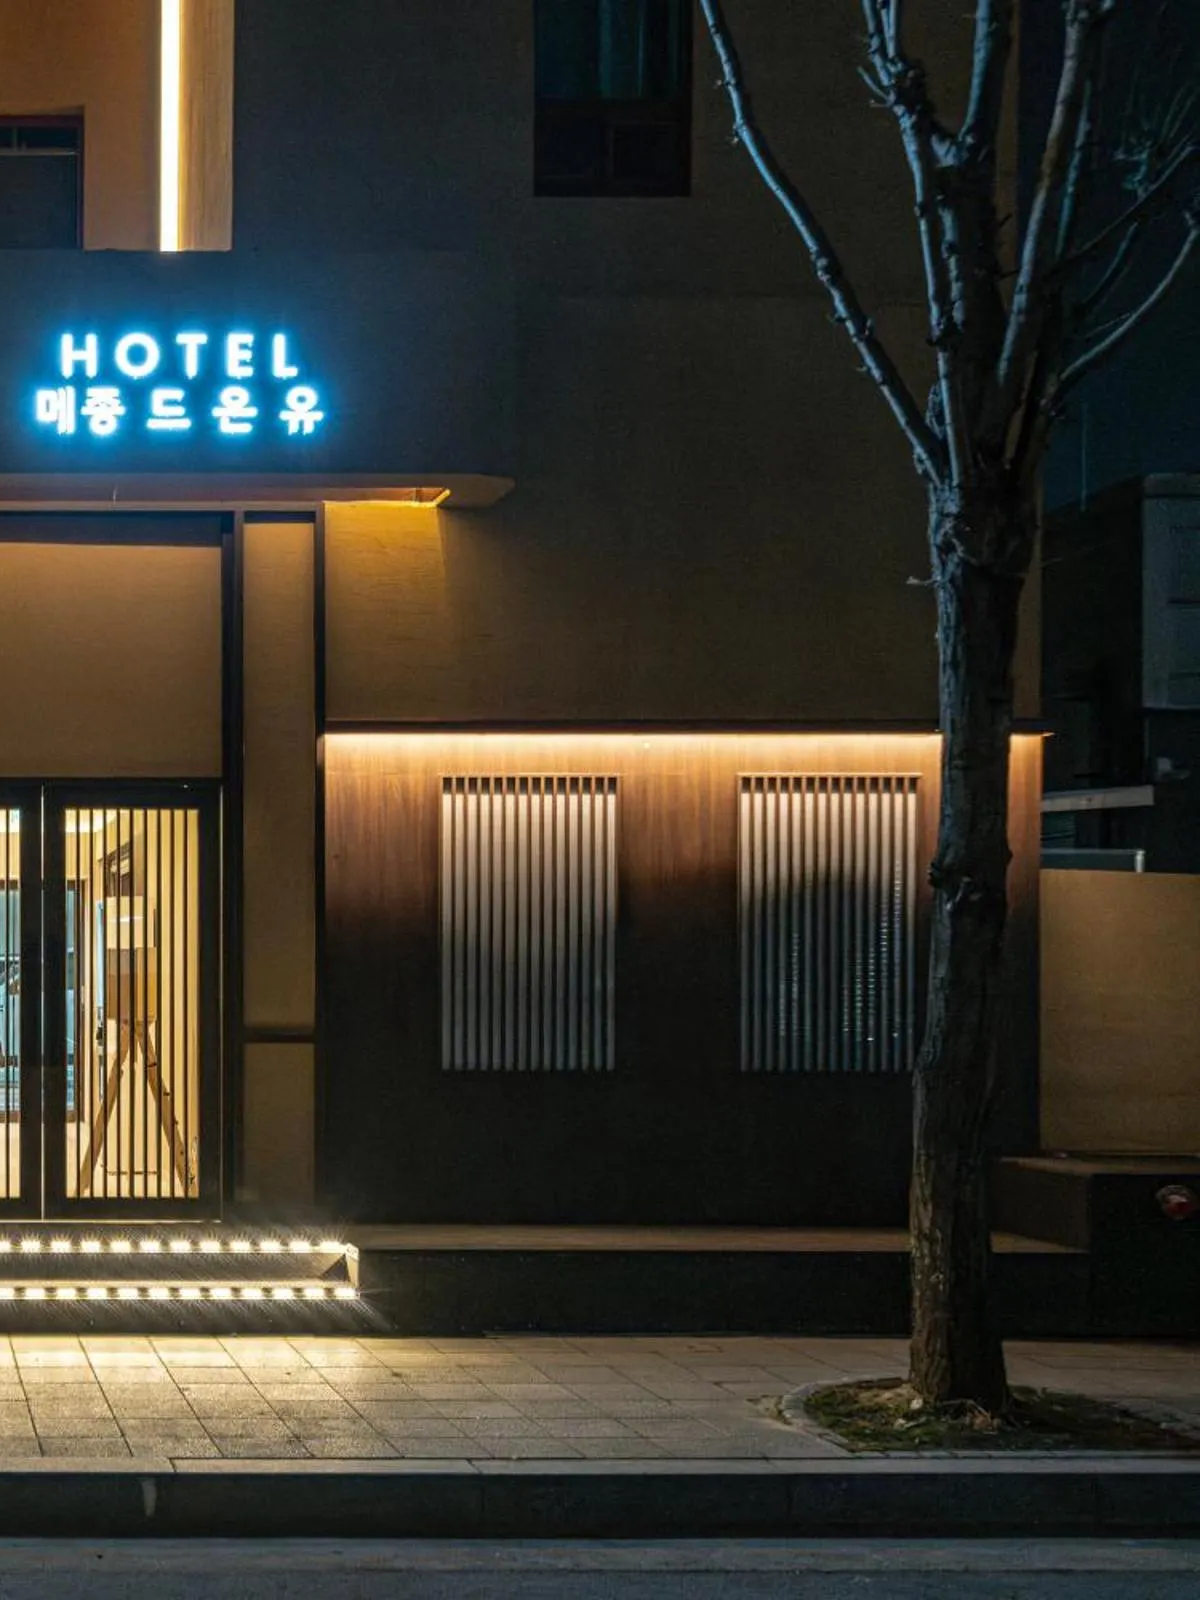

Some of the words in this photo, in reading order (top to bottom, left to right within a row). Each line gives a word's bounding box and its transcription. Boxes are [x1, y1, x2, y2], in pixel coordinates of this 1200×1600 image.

[60, 332, 299, 379] HOTEL
[35, 385, 126, 435] 메종
[147, 387, 192, 430] 드
